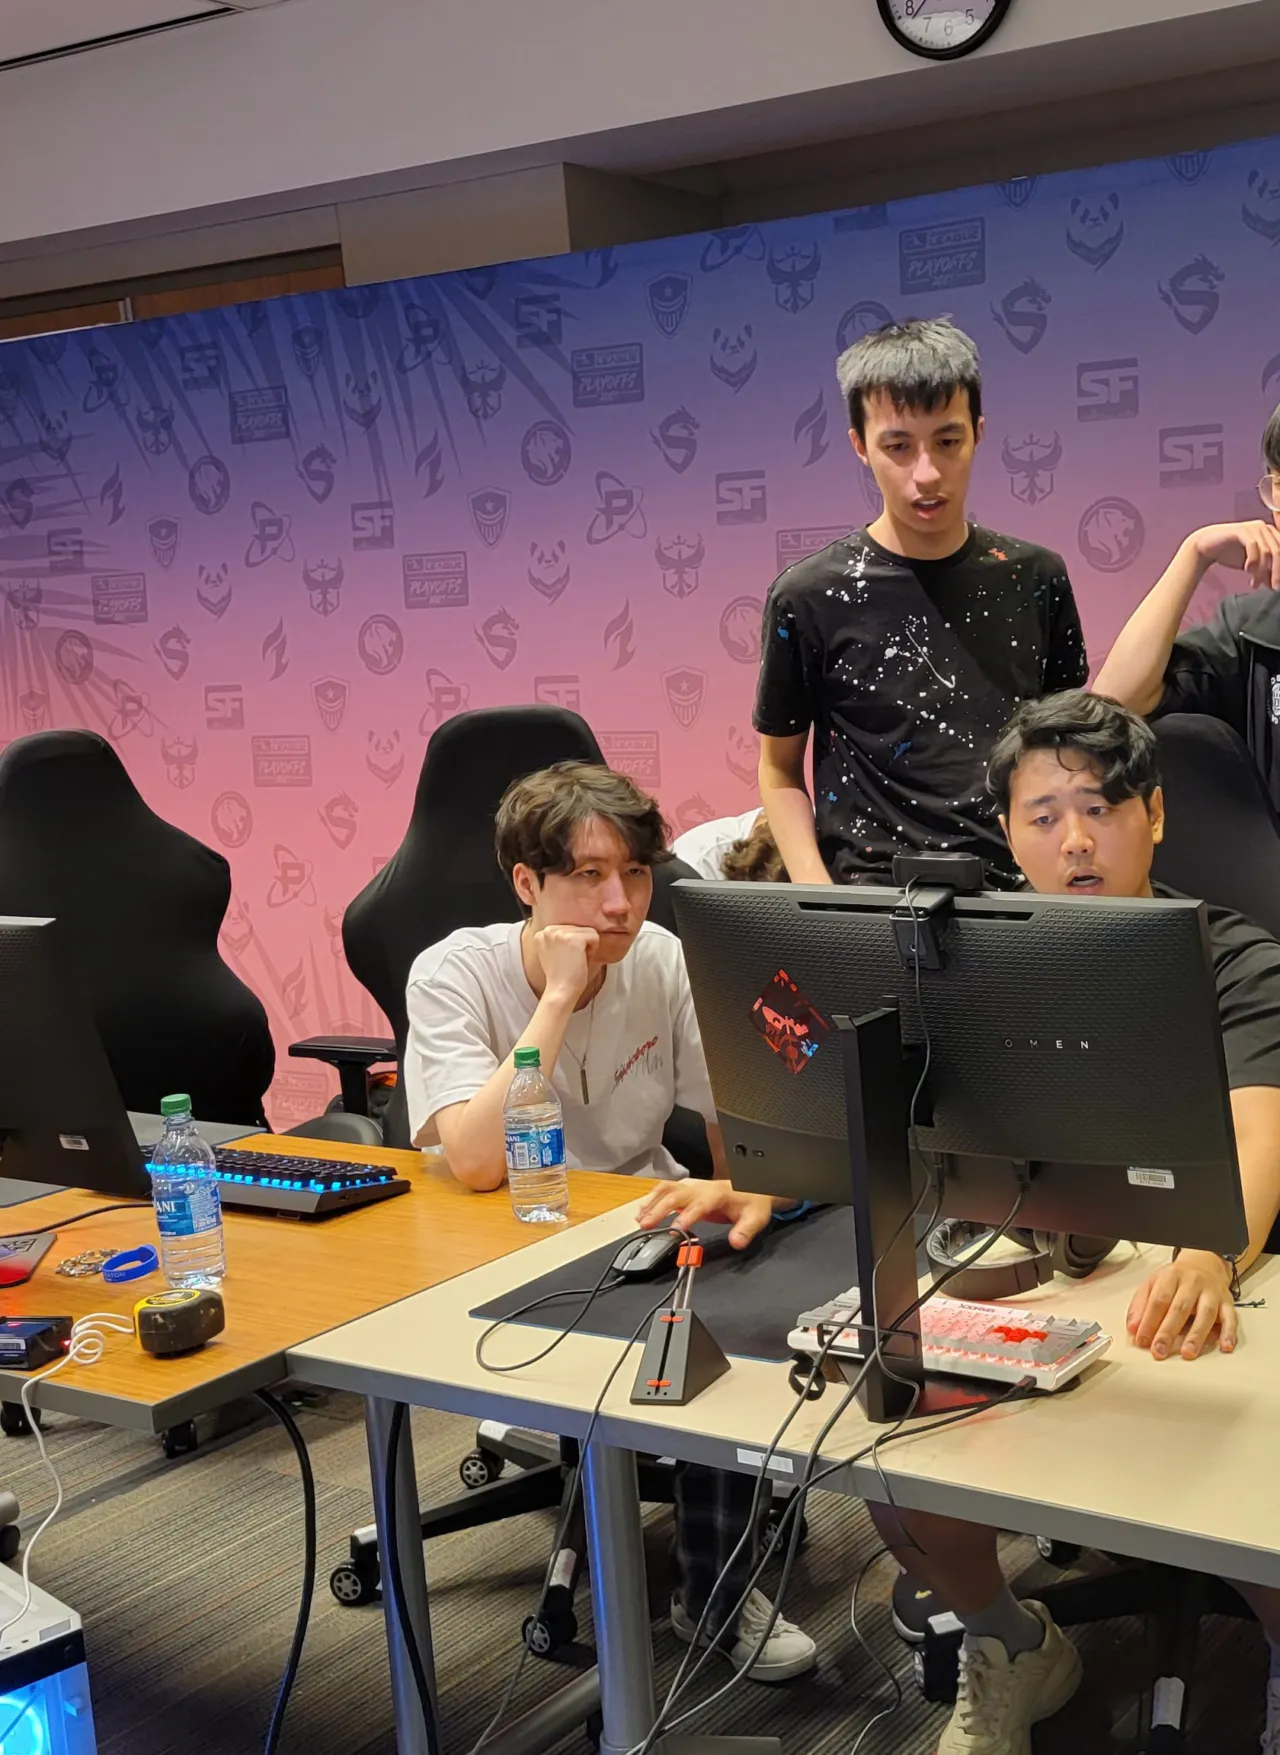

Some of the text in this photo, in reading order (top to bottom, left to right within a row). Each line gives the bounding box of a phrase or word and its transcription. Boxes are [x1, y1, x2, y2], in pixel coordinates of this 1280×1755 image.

[905, 0, 915, 16] 8
[923, 16, 932, 33] 7
[965, 9, 975, 25] 5
[943, 19, 953, 36] 6
[907, 250, 978, 279] PLAYOFFS
[579, 372, 637, 394] PLAYOFFS
[1078, 367, 1139, 406] SF
[1160, 433, 1224, 473] SF
[716, 478, 766, 511] SF
[410, 579, 462, 595] PLAYOFFS
[205, 690, 244, 719] SF
[259, 761, 306, 776] PLAYOFFS
[1004, 1039, 1089, 1049] OMEN
